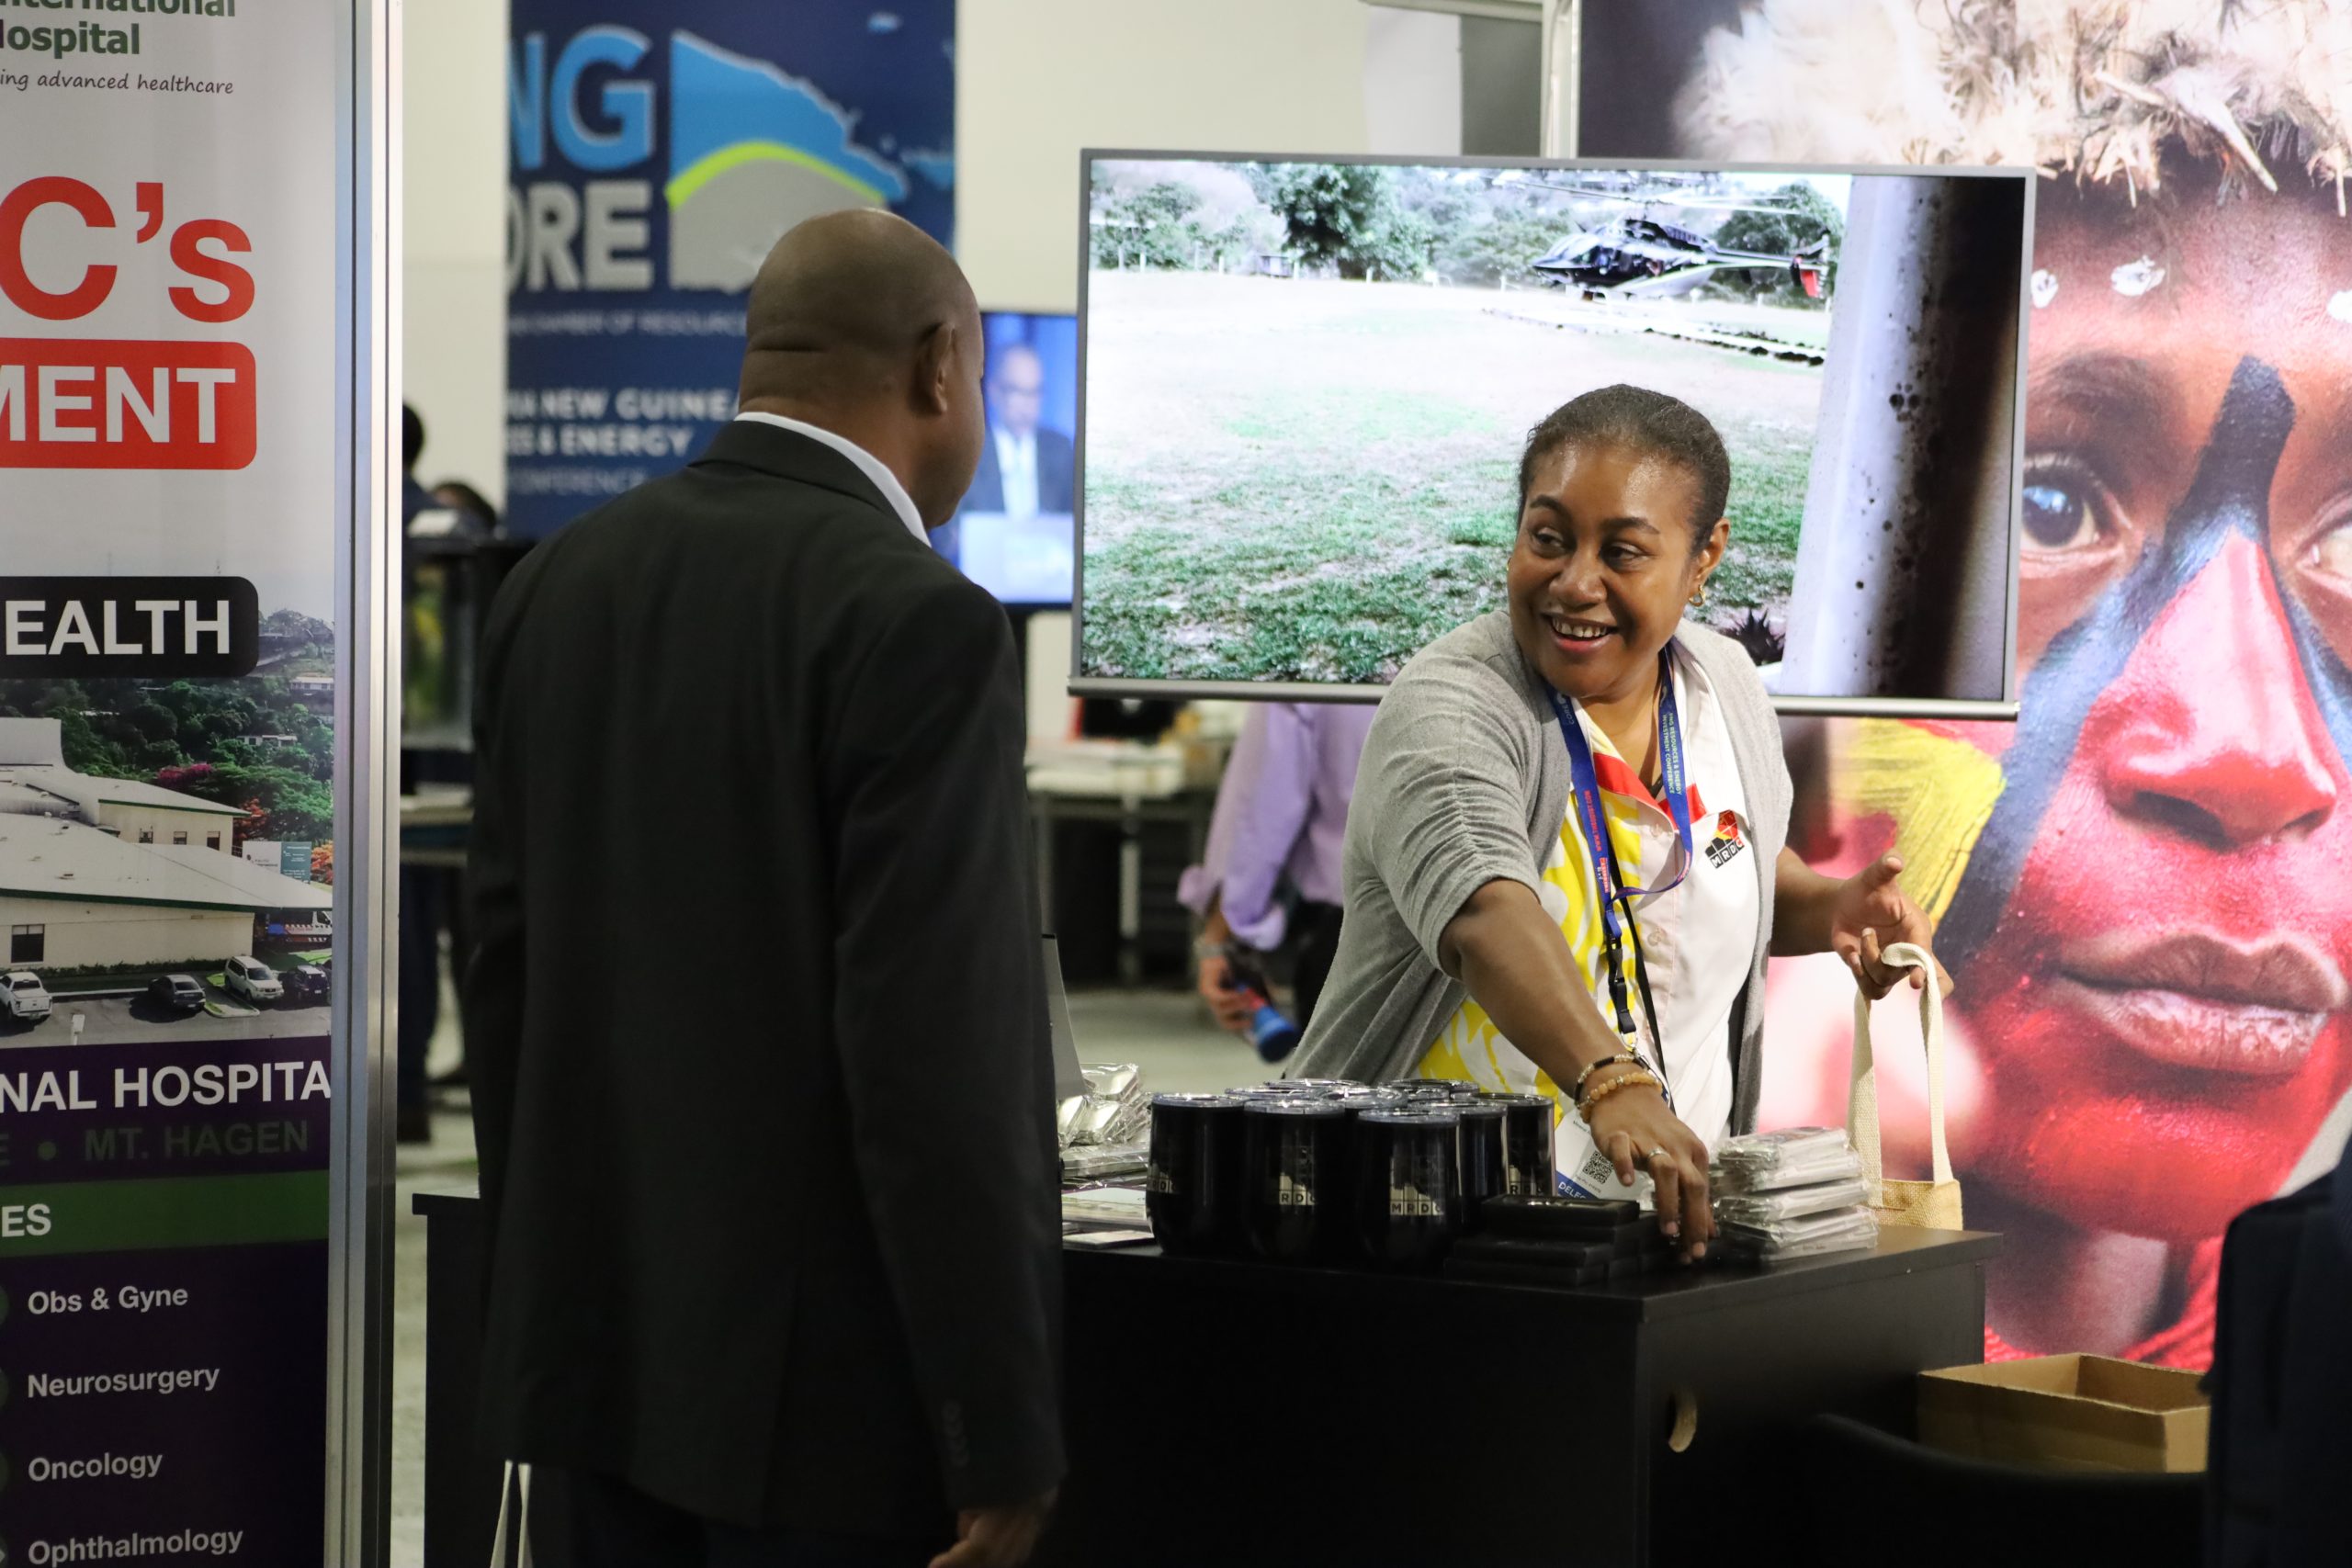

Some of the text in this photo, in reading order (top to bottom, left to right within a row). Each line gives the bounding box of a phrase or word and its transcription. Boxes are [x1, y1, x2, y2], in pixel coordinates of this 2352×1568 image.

[0, 19, 141, 59] ospital
[37, 71, 130, 90] advanced
[137, 73, 233, 94] healthcare
[508, 181, 653, 290] RE
[538, 387, 609, 421] NEW
[614, 386, 739, 422] GUINE
[559, 423, 695, 457] ENERGY
[5, 600, 231, 656] EALTH
[1669, 727, 1679, 763] RESOURCES
[1665, 753, 1675, 795] CONFERENCE
[1710, 838, 1744, 868] MRDC
[114, 1060, 331, 1108] HOSPITA
[85, 1120, 309, 1162] MT. HAGEN
[1, 1203, 51, 1238] ES
[28, 1285, 189, 1314] Obs & Gyne
[28, 1368, 221, 1399] Neurosurgery
[28, 1451, 164, 1483] Oncology
[28, 1528, 244, 1568] Ophthalmology
